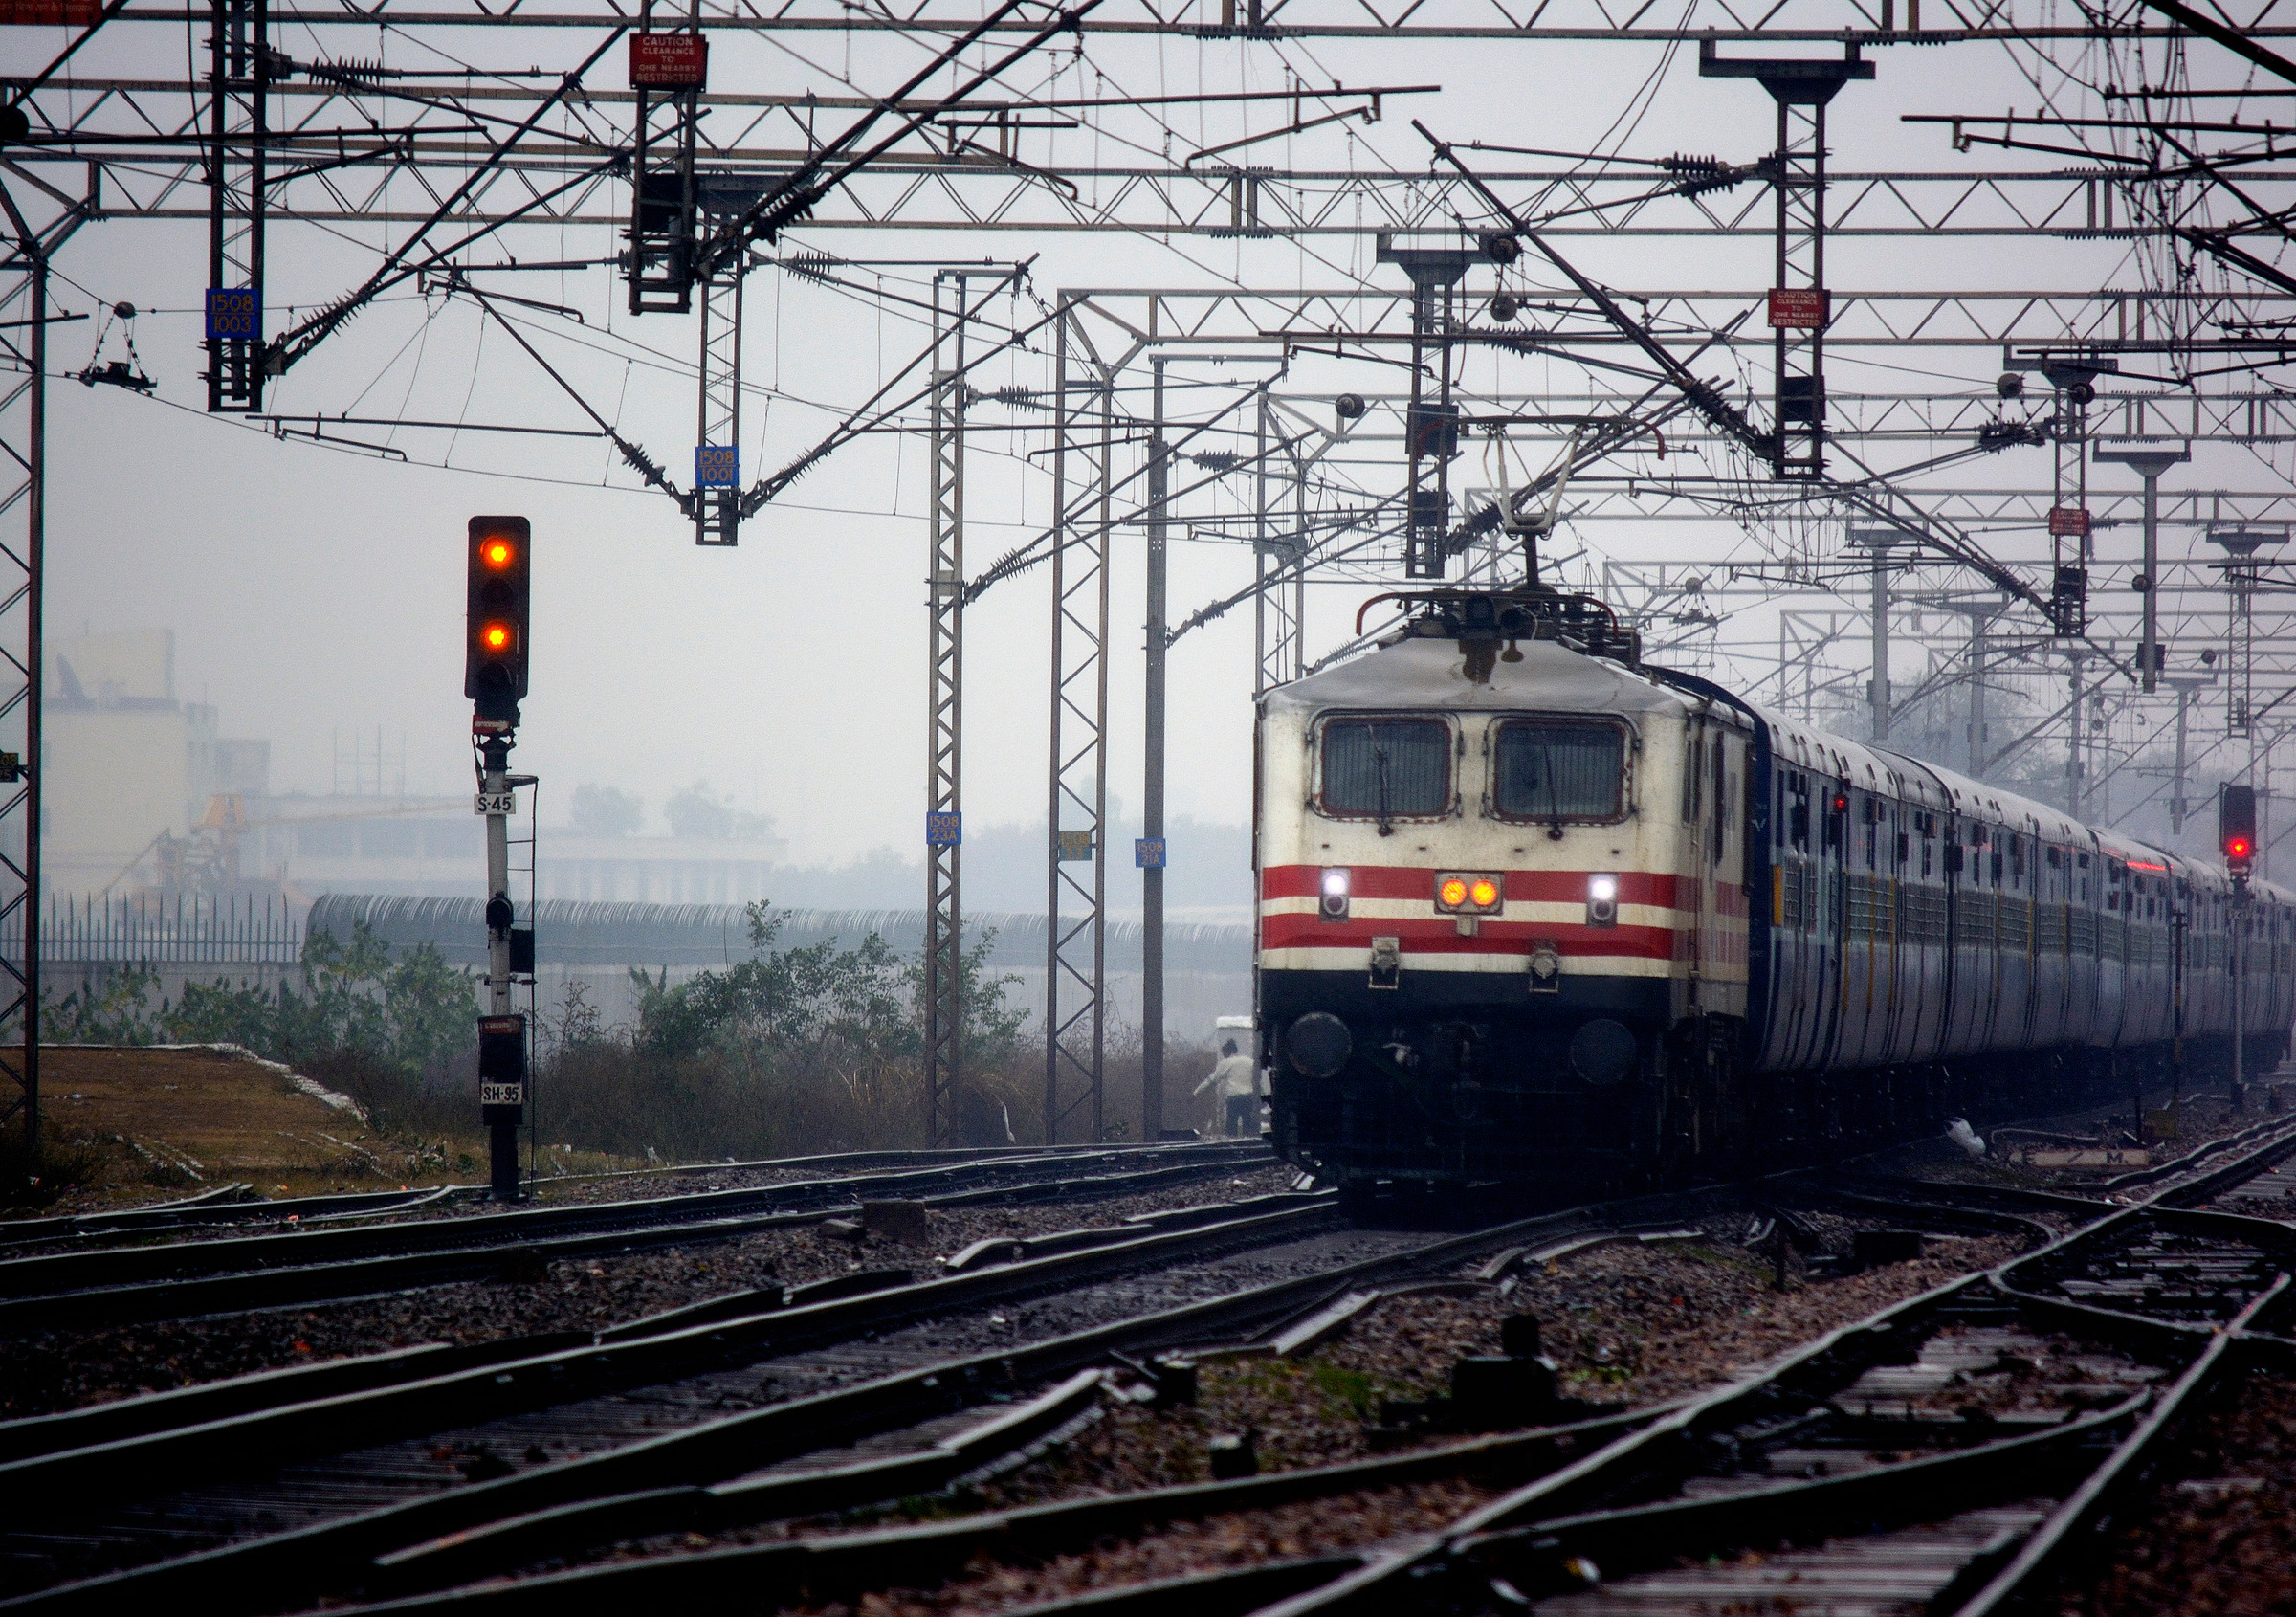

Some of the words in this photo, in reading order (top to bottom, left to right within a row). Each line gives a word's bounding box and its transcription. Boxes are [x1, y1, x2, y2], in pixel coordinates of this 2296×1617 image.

[642, 36, 694, 47] CAUTION
[636, 73, 698, 82] RESTRICTED
[211, 294, 254, 312] 1508
[213, 315, 251, 333] 1003
[699, 450, 734, 465] 1508
[701, 466, 733, 482] 1001
[929, 815, 959, 828] 1508
[932, 828, 957, 841] 23A
[1137, 841, 1163, 853] 1508
[483, 1086, 519, 1102] SH-95
